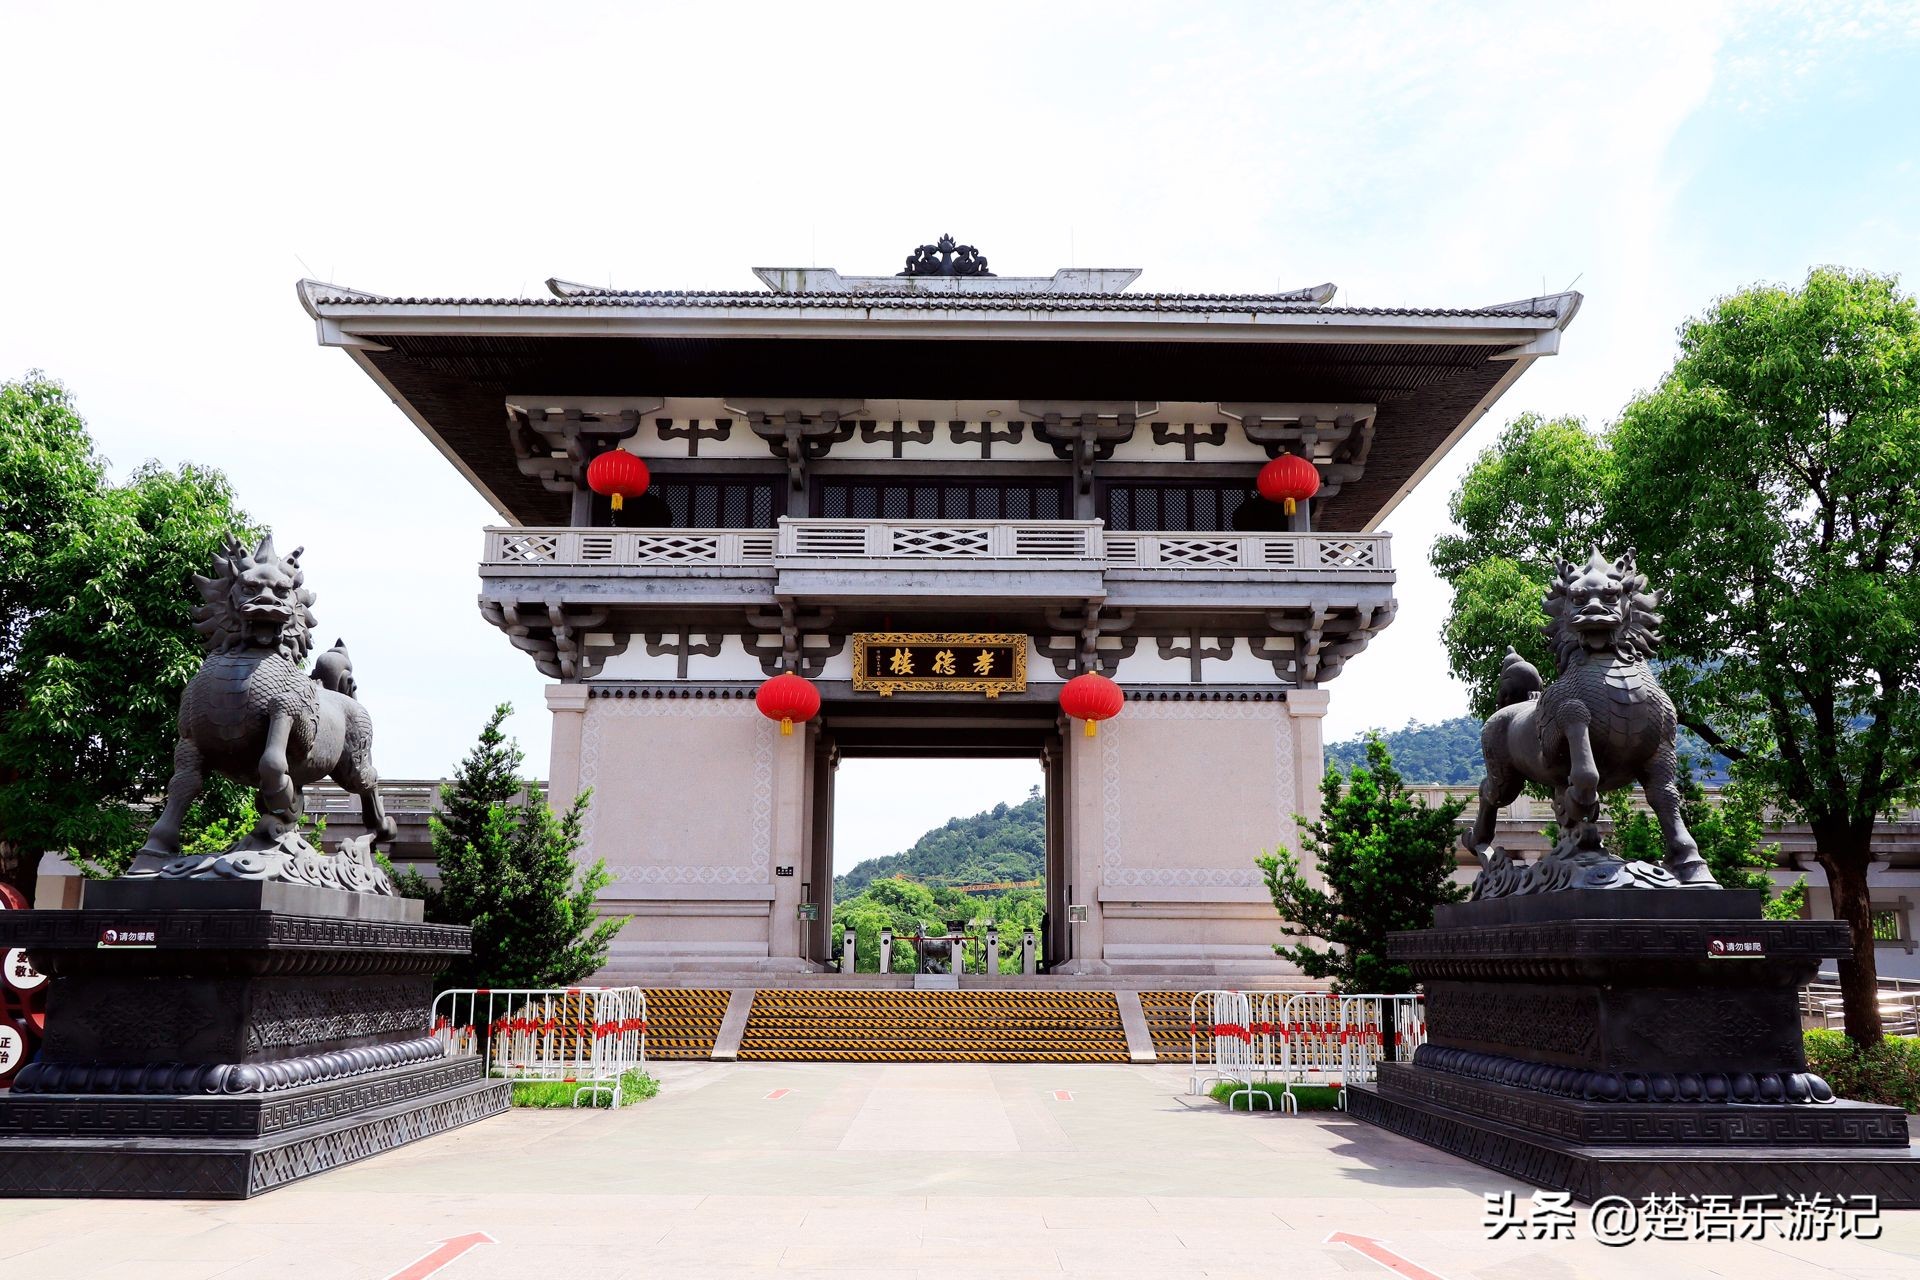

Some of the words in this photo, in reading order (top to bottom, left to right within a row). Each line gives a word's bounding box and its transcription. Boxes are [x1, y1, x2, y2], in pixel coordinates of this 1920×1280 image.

[119, 931, 155, 942] 请勿攀爬
[1726, 942, 1762, 952] 请勿攀爬
